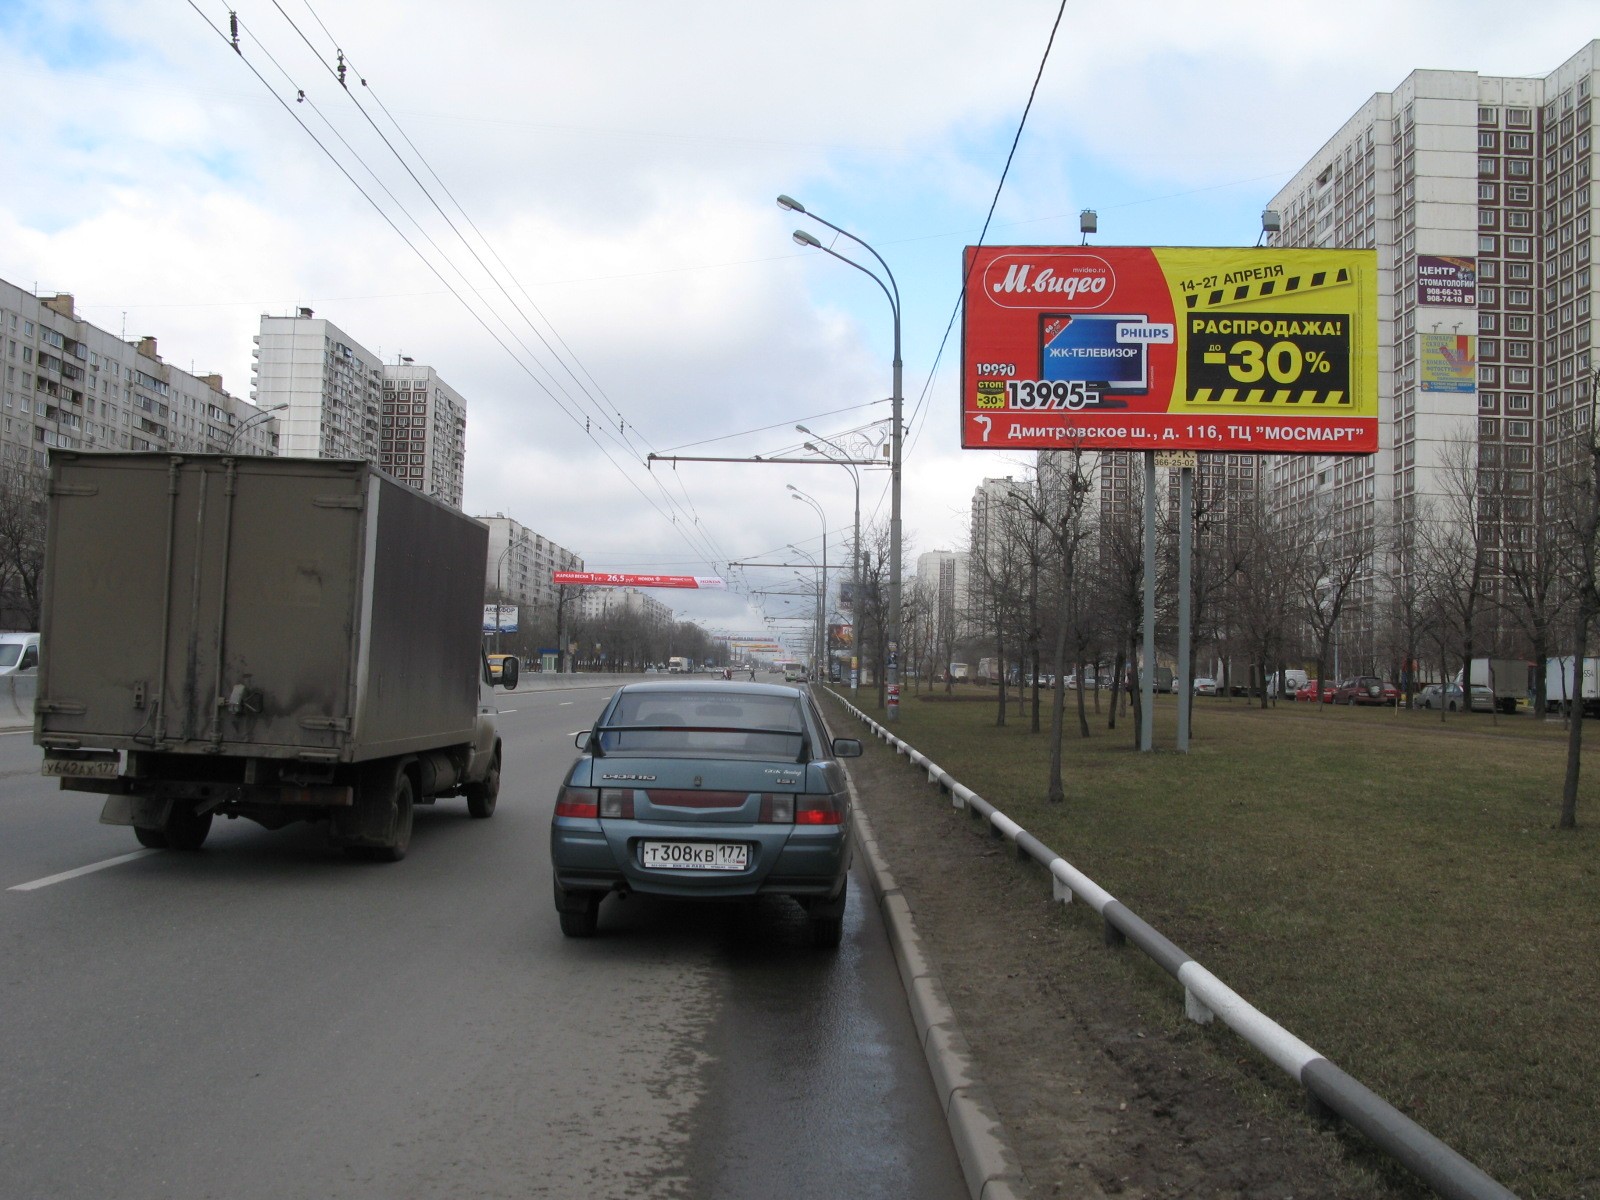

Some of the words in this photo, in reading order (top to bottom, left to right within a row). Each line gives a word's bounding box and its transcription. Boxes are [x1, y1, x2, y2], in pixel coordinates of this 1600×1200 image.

[1419, 266, 1456, 276] ЦЕНТР
[1179, 275, 1218, 292] 14-27
[1223, 265, 1284, 286] АПРЕЛЯ
[1419, 279, 1475, 288] СТОМАТОЛОГИИ
[1121, 328, 1169, 338] PHILIPS
[1192, 320, 1341, 337] РАСПРОДАЖА!
[1209, 344, 1221, 352] ДО
[1050, 349, 1137, 358] ЖК-ТЕЛЕВИЗОР
[1204, 340, 1330, 384] -30%
[976, 363, 1016, 377] 19990
[978, 381, 1004, 389] СТОП!
[978, 396, 1003, 405] -30%
[1008, 424, 1127, 440] Дмитровское
[1163, 429, 1179, 440] д.
[1228, 426, 1251, 441] ТЦ
[1155, 459, 1194, 467] 366-25-02
[607, 574, 625, 583] 26,5
[719, 846, 743, 860] 177
